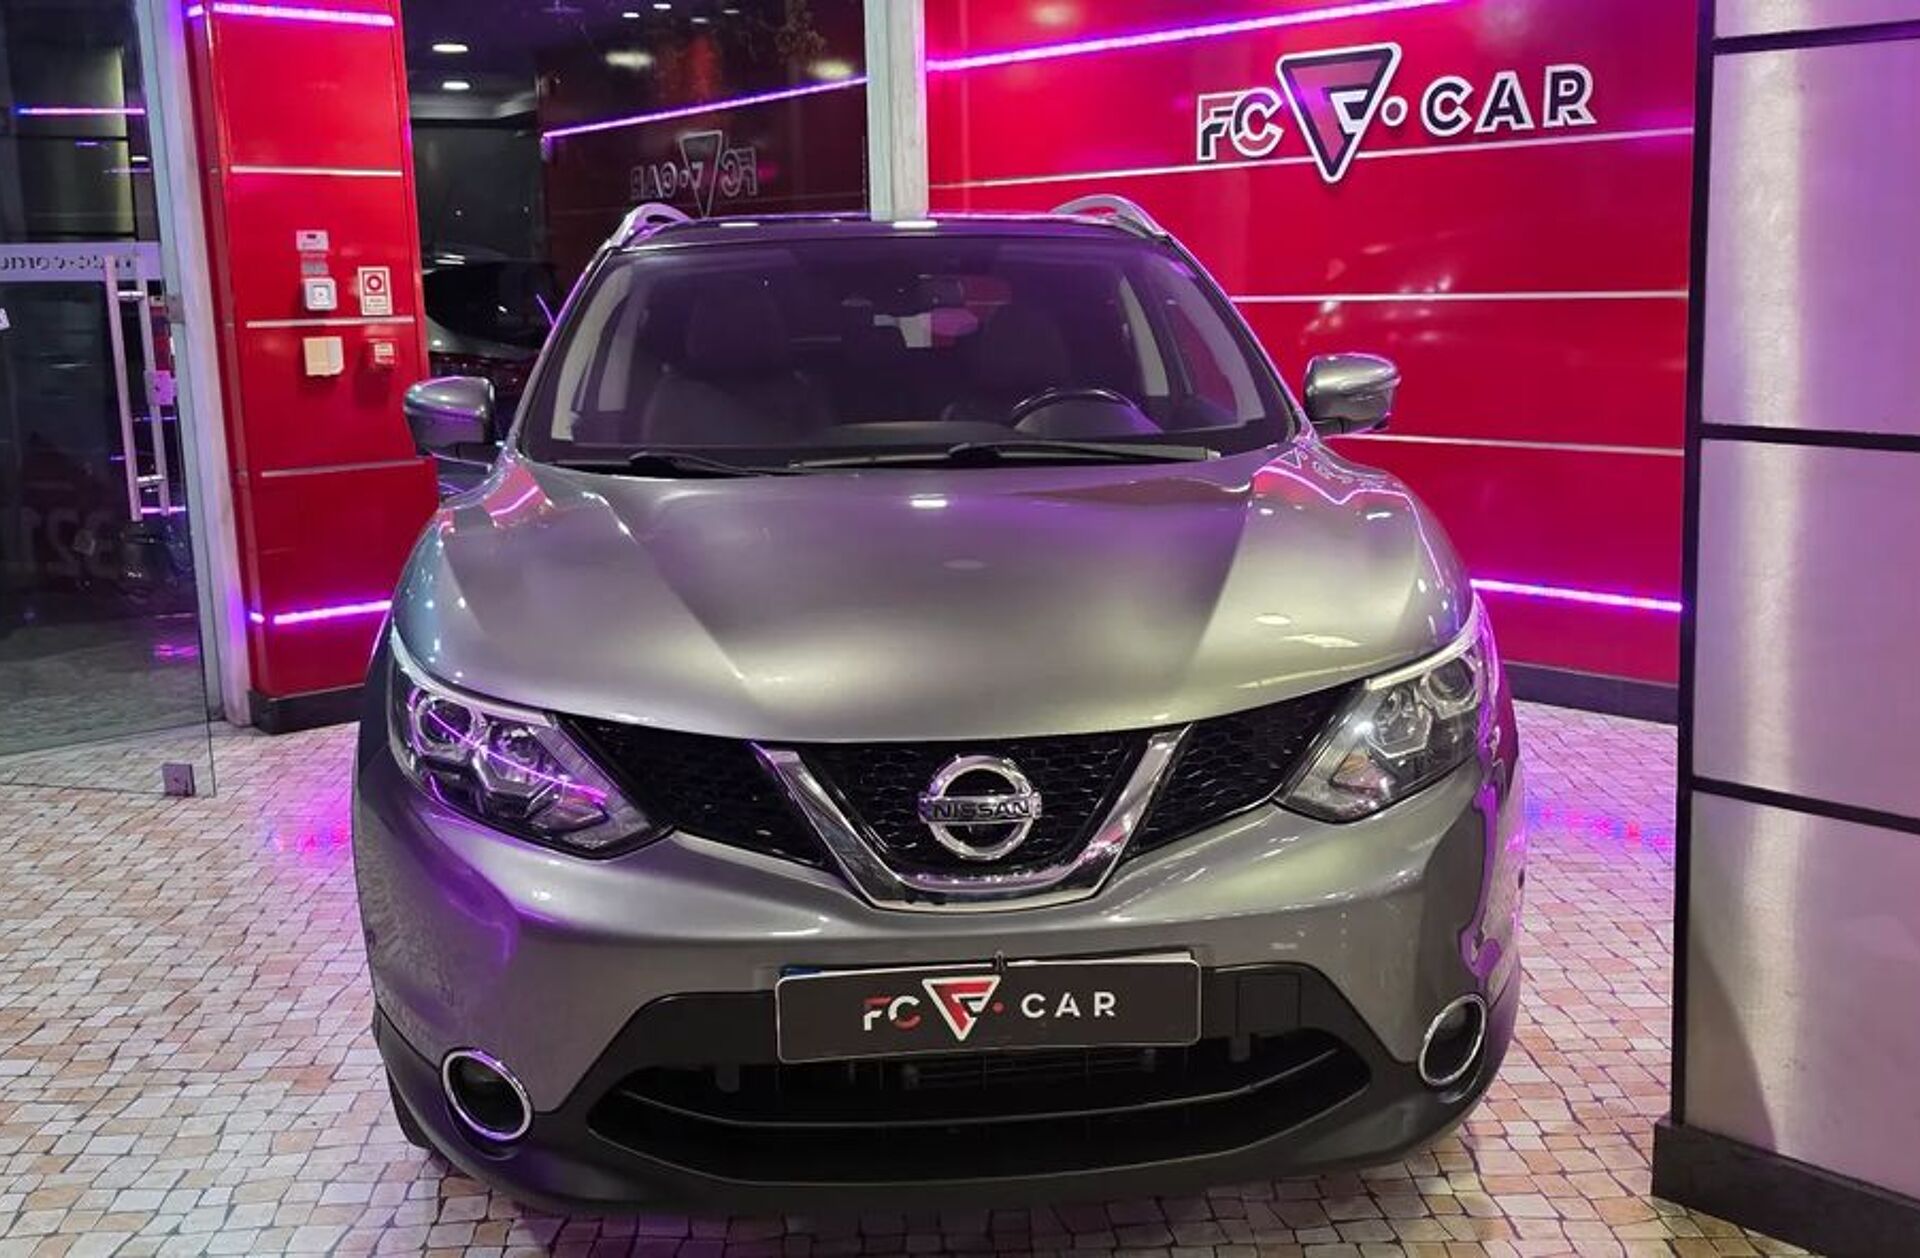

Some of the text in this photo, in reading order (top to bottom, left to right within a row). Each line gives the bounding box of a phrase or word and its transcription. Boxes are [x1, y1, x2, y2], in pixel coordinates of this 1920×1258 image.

[1196, 64, 1597, 161] FC CAR
[932, 800, 1030, 818] NISSAN
[863, 991, 1117, 1031] FC CAR
